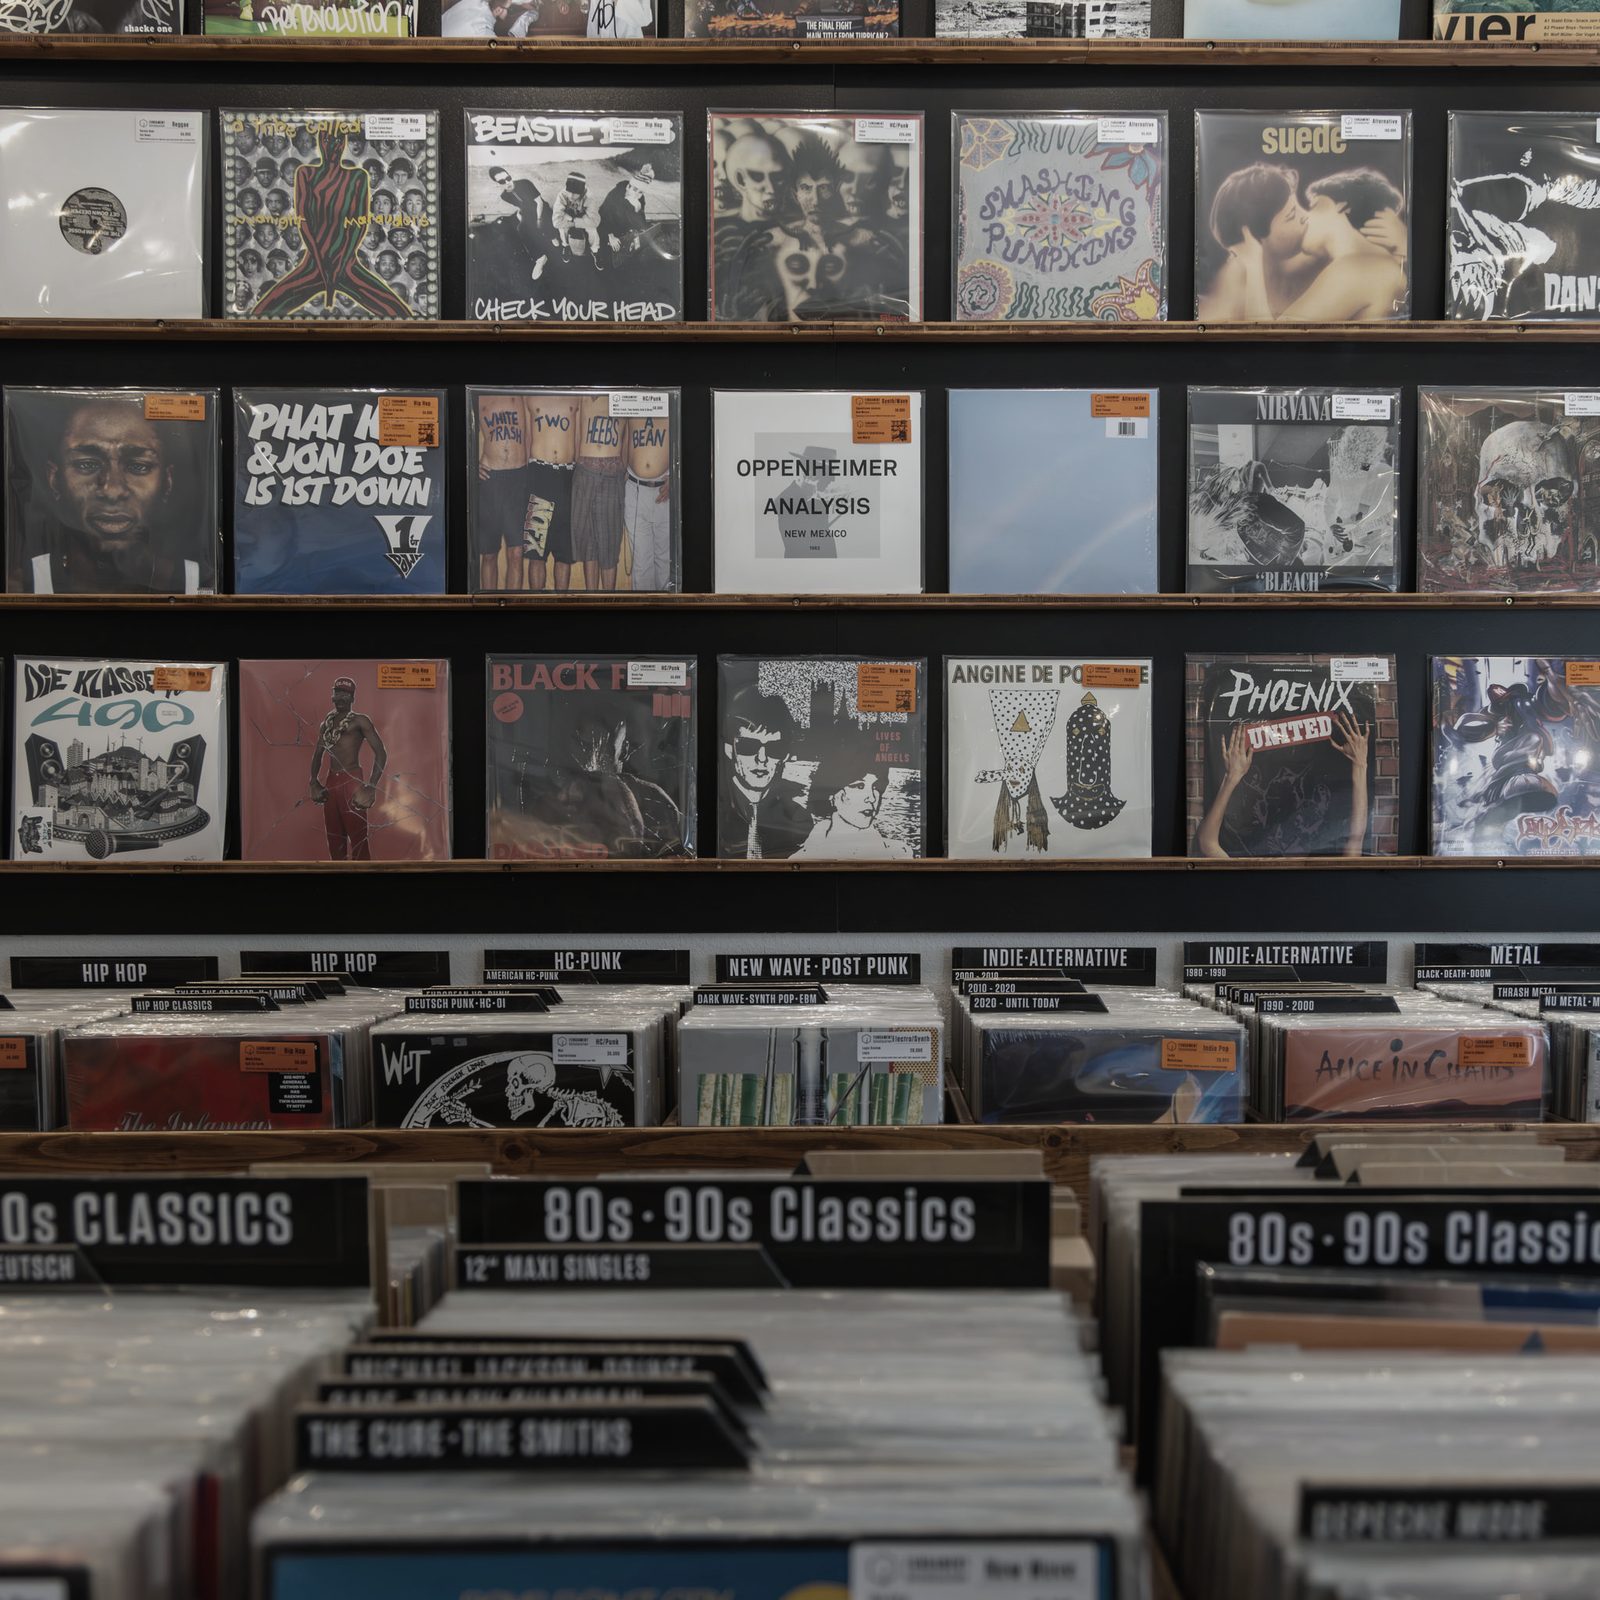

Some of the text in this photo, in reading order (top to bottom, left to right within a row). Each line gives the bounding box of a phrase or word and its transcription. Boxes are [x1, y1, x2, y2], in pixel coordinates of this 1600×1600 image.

[124, 24, 174, 34] shacke one
[806, 21, 852, 30] THE FINAL FIGHT
[401, 117, 409, 125] Hip
[472, 115, 594, 144] BEASTIE
[1262, 126, 1347, 155] suede
[1544, 272, 1600, 313] DAN
[475, 296, 676, 321] CHECK YOUR HEAD
[1255, 395, 1331, 421] NIRVANA
[248, 402, 353, 441] PHAT
[484, 410, 520, 429] WHITE
[534, 414, 570, 433] TWO
[645, 416, 654, 429] A
[489, 426, 522, 445] TRASH
[586, 415, 620, 447] HEEBS
[632, 428, 667, 449] BEAN
[351, 441, 428, 476] DOE
[737, 459, 898, 477] OPPENHEIMER
[244, 475, 277, 506] IS
[332, 475, 432, 506] DOWN
[763, 497, 871, 515] ANALYSIS
[784, 530, 847, 538] NEW MEXICO
[73, 667, 155, 699] KLASSE
[492, 663, 601, 691] BLACK
[952, 664, 1026, 684] ANGINE
[1032, 664, 1053, 684] DE
[30, 697, 195, 733] 490
[875, 731, 902, 741] LIVES
[1247, 715, 1332, 750] UNITED
[879, 743, 891, 752] OF
[875, 753, 911, 763] ANGELS
[312, 952, 377, 972] HIP HOP
[1490, 945, 1541, 965] METAL
[82, 963, 147, 983] HIP HOP
[486, 970, 524, 981] AMERICAN
[729, 958, 763, 977] NEW
[867, 955, 909, 976] PUNK
[1185, 968, 1227, 977] 1980 1990
[968, 983, 1016, 992] 2010 2020
[1498, 987, 1529, 997] THRASH
[136, 999, 213, 1012] HIP HOP CLASSICS
[409, 997, 449, 1009] DEUTSCH
[697, 993, 720, 1004] DARK
[974, 997, 1060, 1009] 2020 UNTIL TODAY
[1263, 1001, 1315, 1011] 1990 2000
[1545, 996, 1557, 1007] NU
[1218, 1045, 1229, 1053] Pop
[0, 1192, 293, 1245] 0s CLASSICS
[770, 1185, 976, 1242] Classics
[505, 1255, 559, 1281] MAXI
[563, 1254, 651, 1281] SINGLES
[308, 1419, 364, 1456] THE
[520, 1418, 632, 1456] SMITHS
